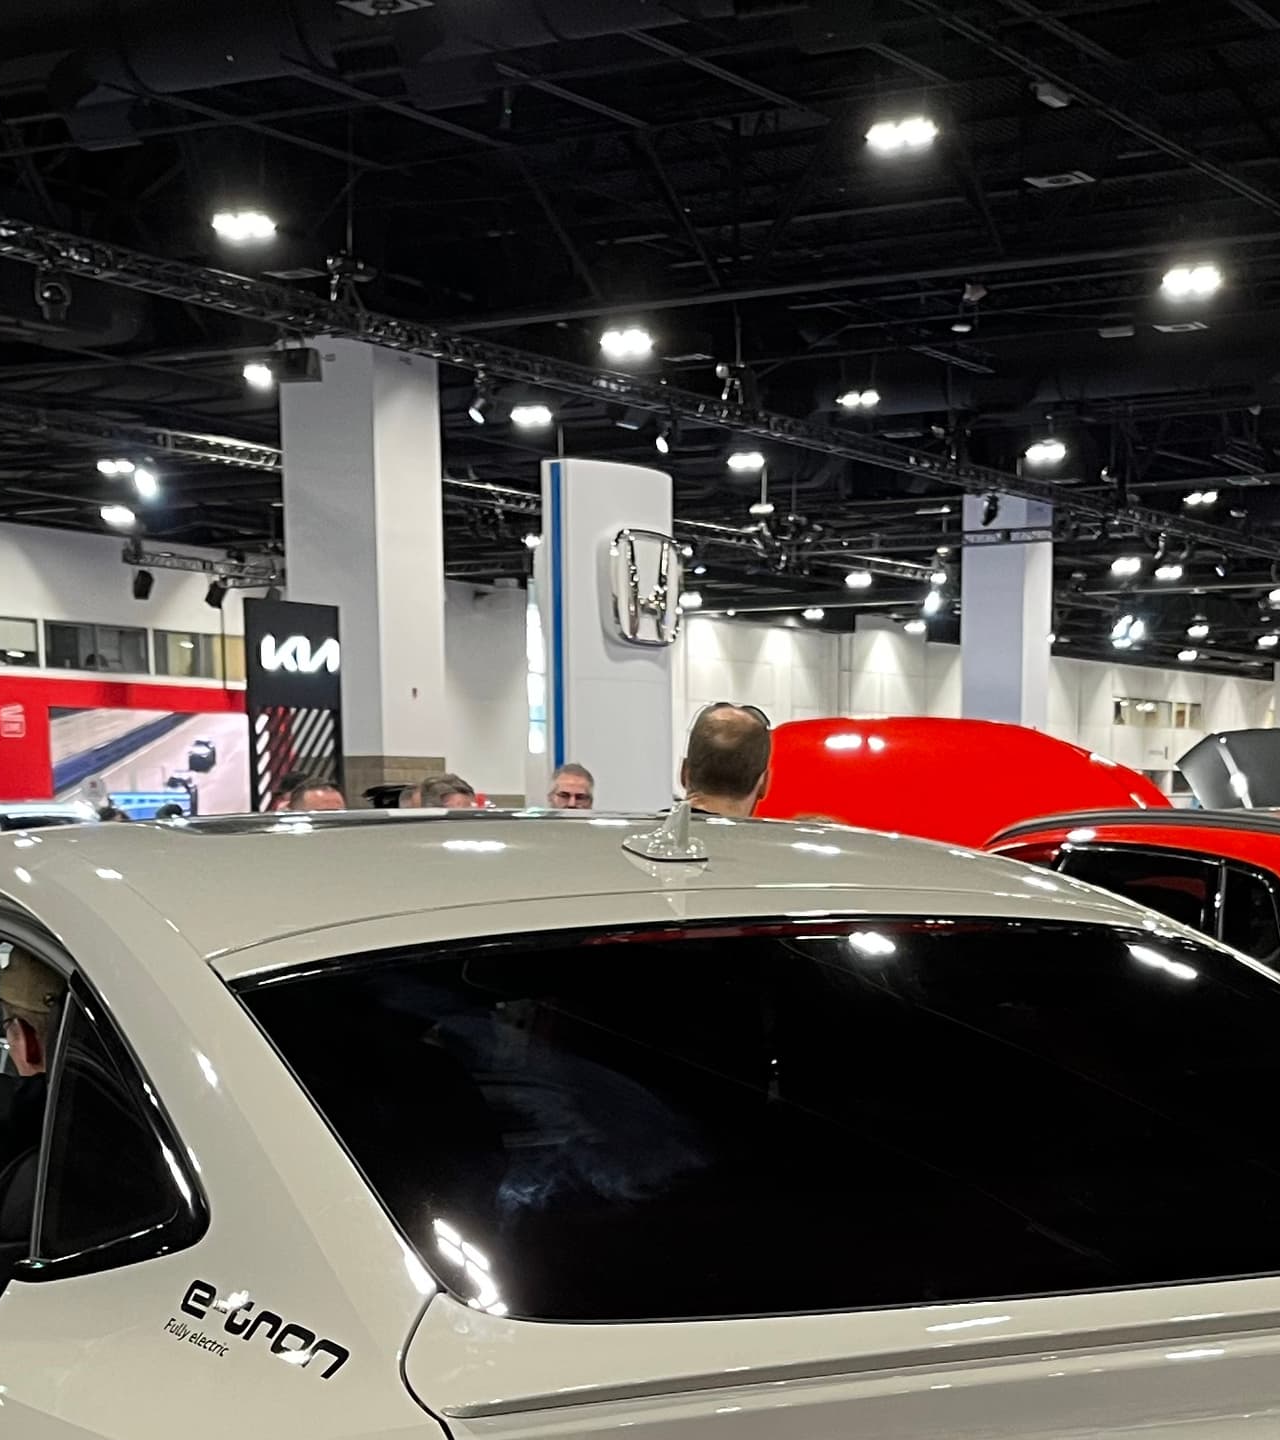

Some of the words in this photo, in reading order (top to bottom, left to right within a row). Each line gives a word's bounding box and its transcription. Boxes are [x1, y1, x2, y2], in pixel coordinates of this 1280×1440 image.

[261, 634, 340, 672] KIA
[163, 1317, 191, 1341] Fully
[188, 1332, 230, 1357] electric
[180, 1279, 350, 1380] e-tron
